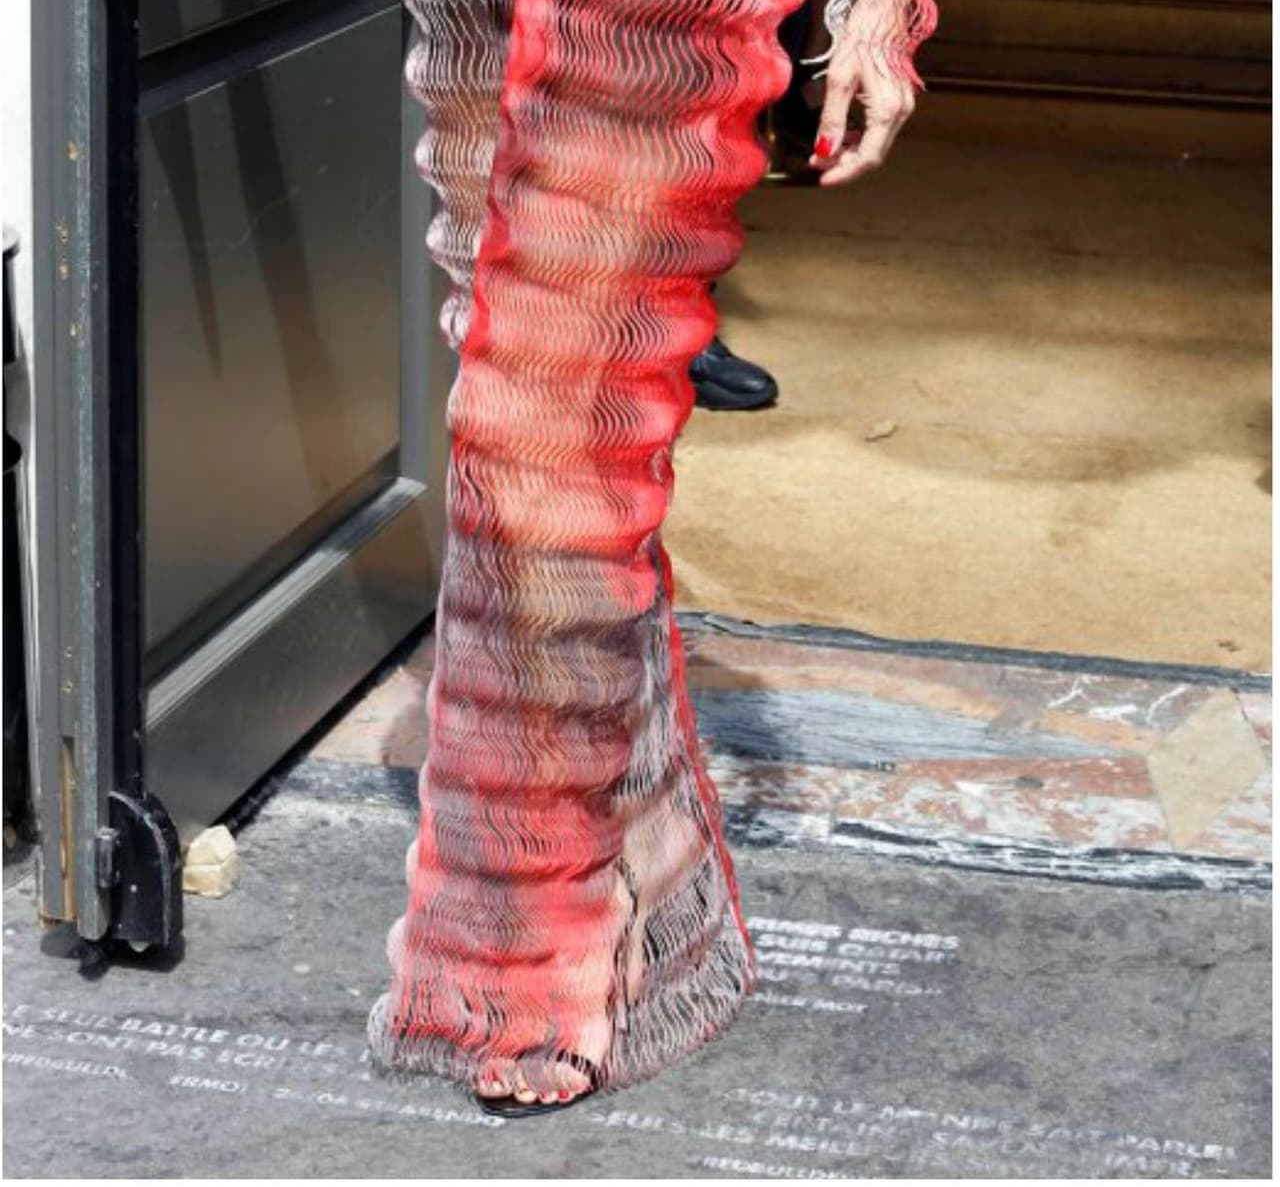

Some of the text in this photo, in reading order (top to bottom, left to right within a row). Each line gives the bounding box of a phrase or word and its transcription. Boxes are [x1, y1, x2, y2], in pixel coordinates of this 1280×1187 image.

[119, 1018, 230, 1043] BATTLE
[236, 1033, 290, 1051] OU
[144, 1040, 209, 1060] PAS
